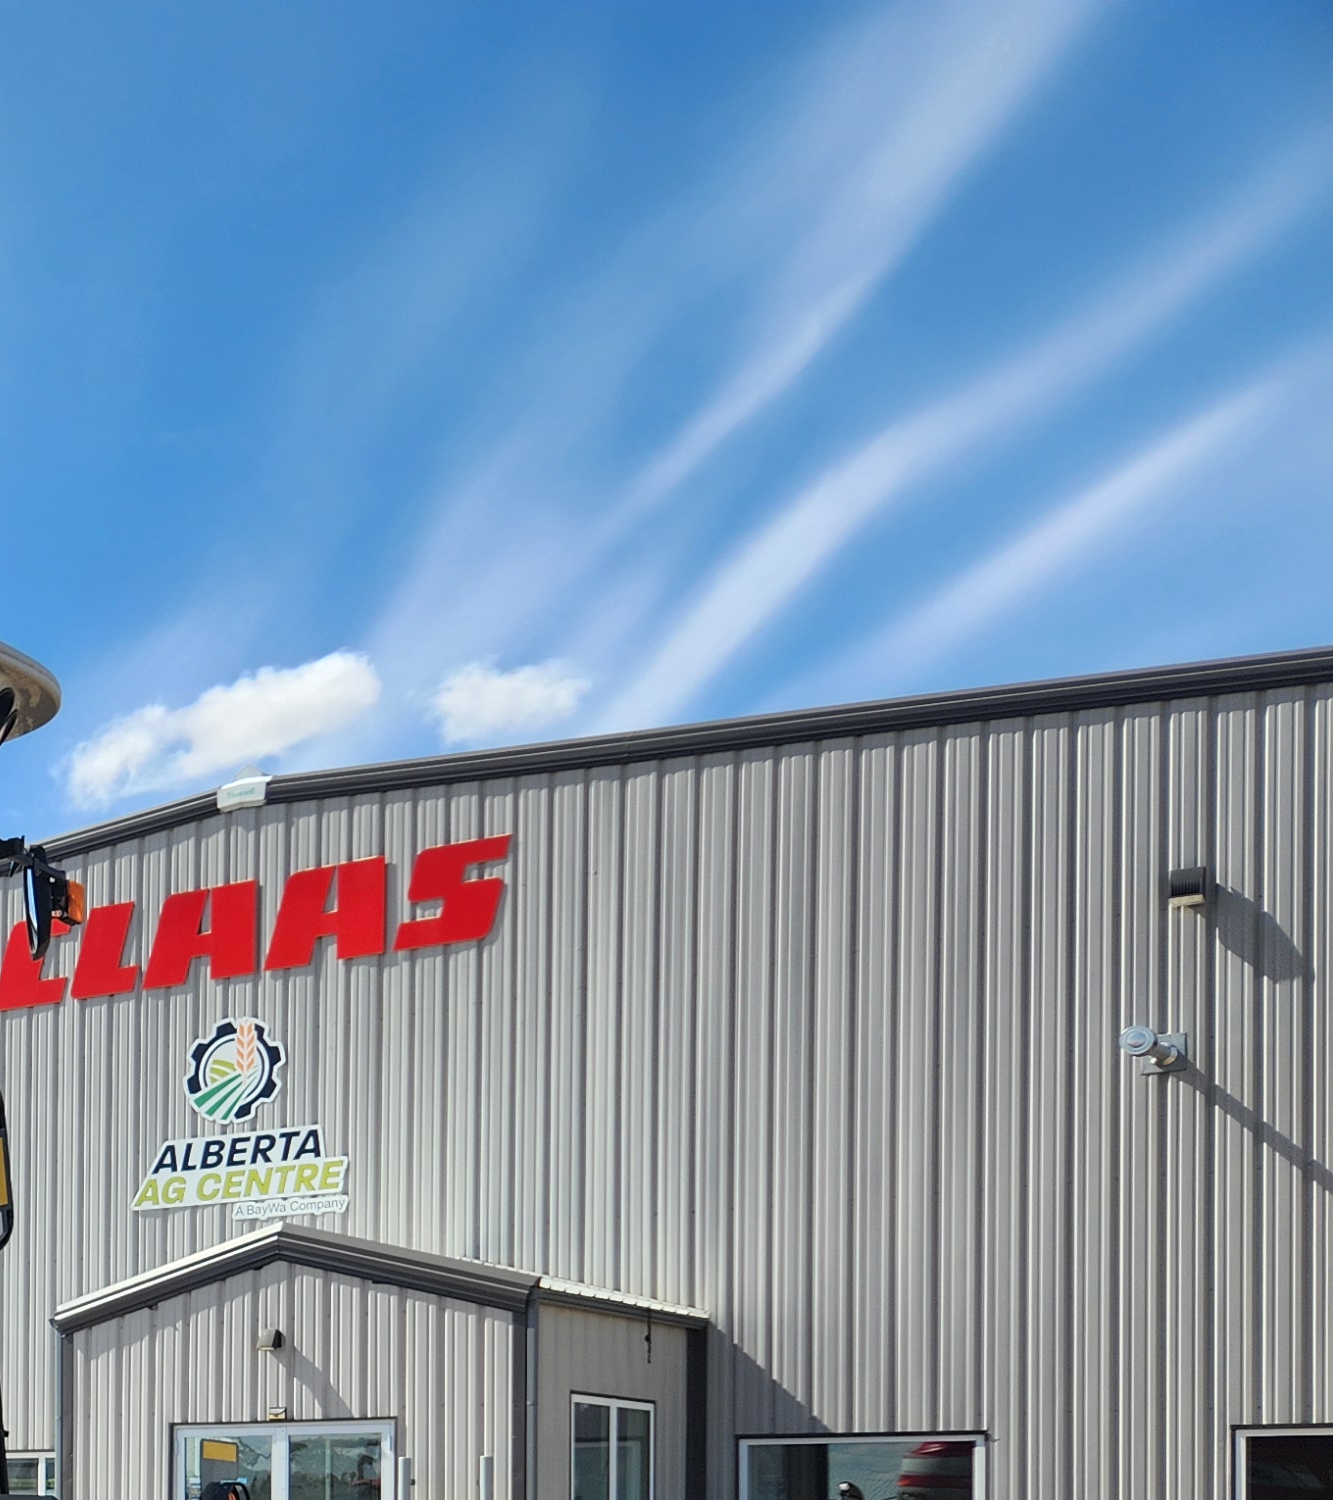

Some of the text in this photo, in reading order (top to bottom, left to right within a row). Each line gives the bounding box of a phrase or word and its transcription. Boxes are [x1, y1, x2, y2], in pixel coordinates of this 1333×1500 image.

[153, 1128, 323, 1175] ALBERTA
[135, 1158, 347, 1207] AG CENTRE
[235, 1198, 345, 1217] A BayWa Company
